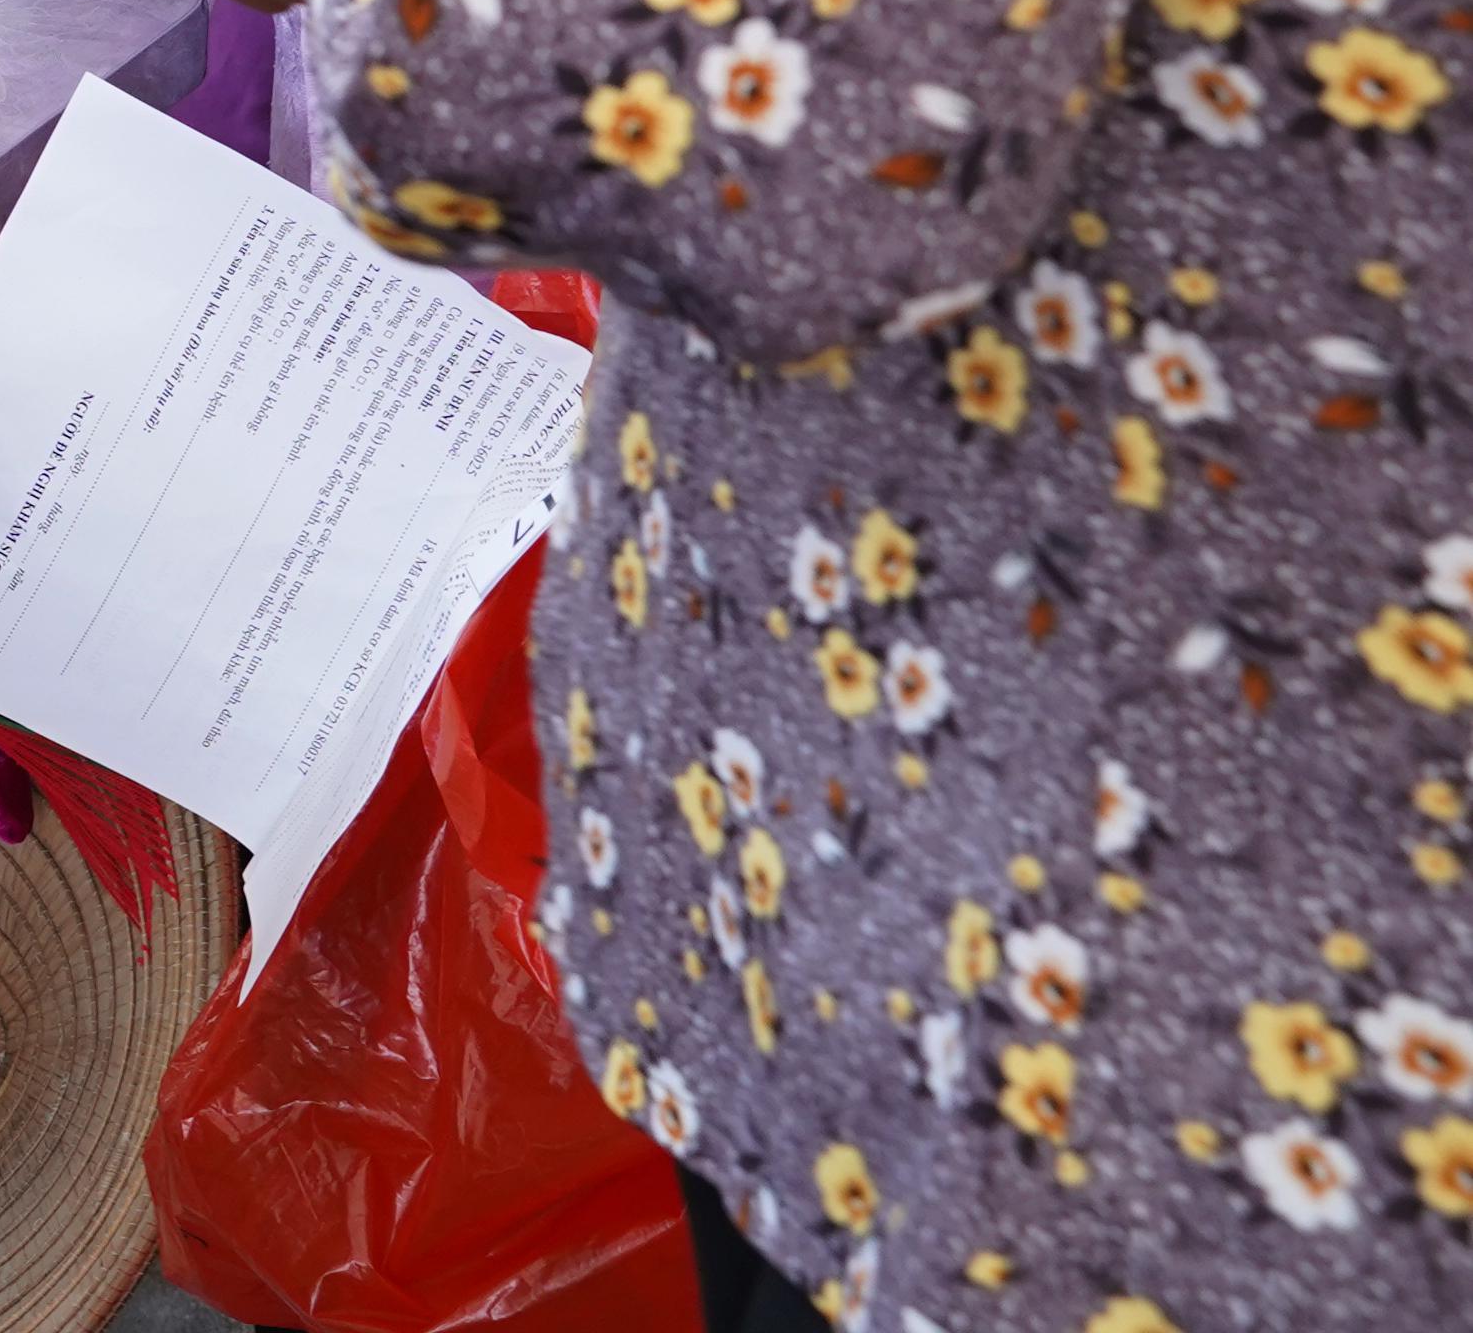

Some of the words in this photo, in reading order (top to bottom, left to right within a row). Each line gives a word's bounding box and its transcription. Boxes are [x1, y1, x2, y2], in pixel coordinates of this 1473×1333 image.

[259, 203, 276, 218] 3.
[244, 213, 272, 245] Tiền
[272, 214, 297, 244] Năm
[236, 239, 253, 257] sử
[256, 238, 282, 266] phát
[224, 254, 246, 279] sản
[242, 261, 269, 293] hiện:
[336, 250, 359, 276] Anh
[364, 261, 380, 276] 2.
[207, 274, 232, 302] phụ
[320, 288, 336, 304] có
[325, 271, 346, 292] chị
[349, 271, 375, 302] Tiền
[380, 273, 405, 299] Nếu
[193, 300, 220, 334] khoa
[302, 300, 328, 331] đang
[340, 297, 359, 315] sử
[414, 294, 444, 333] đường,
[443, 304, 463, 325] Có
[329, 310, 352, 336] bản
[357, 320, 377, 339] đề
[437, 320, 452, 334] ai
[467, 316, 484, 331] 1.
[178, 331, 207, 364] (Đối
[290, 327, 317, 356] mắc
[311, 332, 338, 367] thân:
[341, 332, 367, 361] nghị
[403, 329, 424, 352] lao,
[419, 329, 445, 360] trong
[453, 326, 480, 356] Tiền
[485, 327, 505, 349] III.
[508, 341, 526, 359] 19.
[167, 360, 188, 383] với
[273, 351, 299, 383] bệnh
[329, 356, 352, 380] ghi
[391, 347, 411, 370] hen
[409, 355, 429, 376] gia
[444, 350, 463, 369] sử
[466, 344, 496, 380] TIỀN
[489, 353, 518, 386] Ngày
[529, 354, 547, 371] 17.
[265, 379, 284, 397] gì
[321, 376, 339, 394] cụ
[377, 366, 404, 393] phế
[395, 372, 421, 402] đình
[432, 363, 454, 385] gia
[518, 367, 539, 390] Mã
[550, 366, 569, 385] 16.
[152, 378, 176, 407] phụ
[311, 392, 335, 417] thể
[359, 387, 388, 422] quản,
[416, 381, 443, 415] đình:
[473, 380, 502, 414] khám
[502, 397, 519, 414] sở
[510, 385, 526, 401] cơ
[533, 379, 559, 408] Lượt
[58, 389, 99, 443] NGƯỜI
[138, 405, 164, 435] nữ):
[242, 393, 276, 437] không:
[301, 411, 322, 434] tên
[382, 397, 405, 423] ông
[432, 392, 465, 433] BỆNH
[462, 408, 485, 432] sức
[516, 403, 545, 438] khám:
[346, 418, 369, 444] ung
[368, 419, 393, 448] (bà)
[483, 410, 512, 445] KCB:
[47, 439, 73, 465] ĐỀ
[281, 430, 311, 467] bệnh:
[334, 441, 358, 469] thư,
[355, 444, 383, 474] mắc
[463, 439, 493, 478] 36025
[66, 447, 94, 480] ngày
[24, 459, 58, 502] NGHỊ
[317, 466, 344, 499] động
[340, 468, 366, 497] một
[3, 499, 40, 546] KHÁM
[34, 499, 66, 537] tháng
[302, 497, 330, 532] kinh,
[323, 493, 351, 527] trong
[293, 528, 315, 550] rối
[314, 526, 336, 550] các
[417, 536, 438, 559] 18.
[277, 544, 303, 573] loạn
[294, 545, 324, 582] bệnh:
[406, 555, 428, 580] Mã
[5, 566, 28, 593] năm
[266, 571, 289, 596] tâm
[387, 574, 416, 606] định
[250, 593, 279, 626] thần,
[274, 577, 309, 619] truyền
[374, 602, 401, 634] danh
[233, 621, 260, 654] bệnh
[253, 613, 289, 658] nhiễm,
[366, 629, 382, 647] cơ
[216, 650, 244, 685] khác:
[243, 653, 264, 677] tim
[358, 645, 377, 663] sở
[222, 673, 252, 711] mạch,
[339, 661, 367, 696] KCB:
[213, 706, 234, 728] đái
[293, 693, 348, 776] 037211800317
